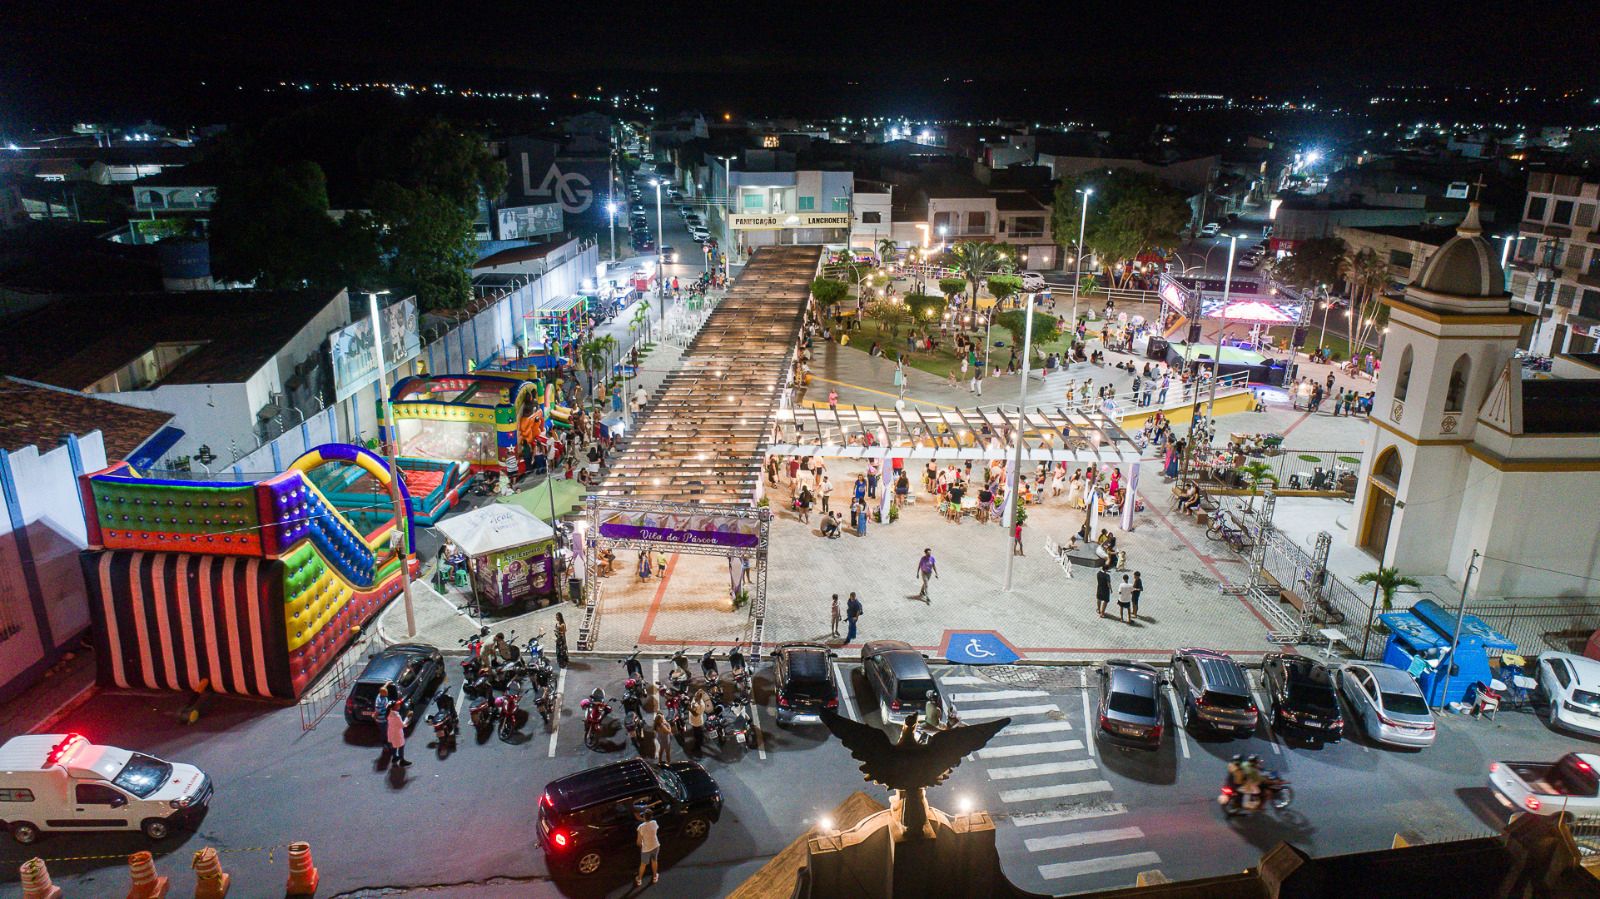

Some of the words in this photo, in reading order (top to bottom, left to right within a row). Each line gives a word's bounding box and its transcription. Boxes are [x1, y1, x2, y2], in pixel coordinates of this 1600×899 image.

[735, 217, 777, 226] PANIFICAÇÃO
[640, 529, 663, 541] Vila
[666, 533, 680, 542] da
[683, 532, 719, 544] Páscoa
